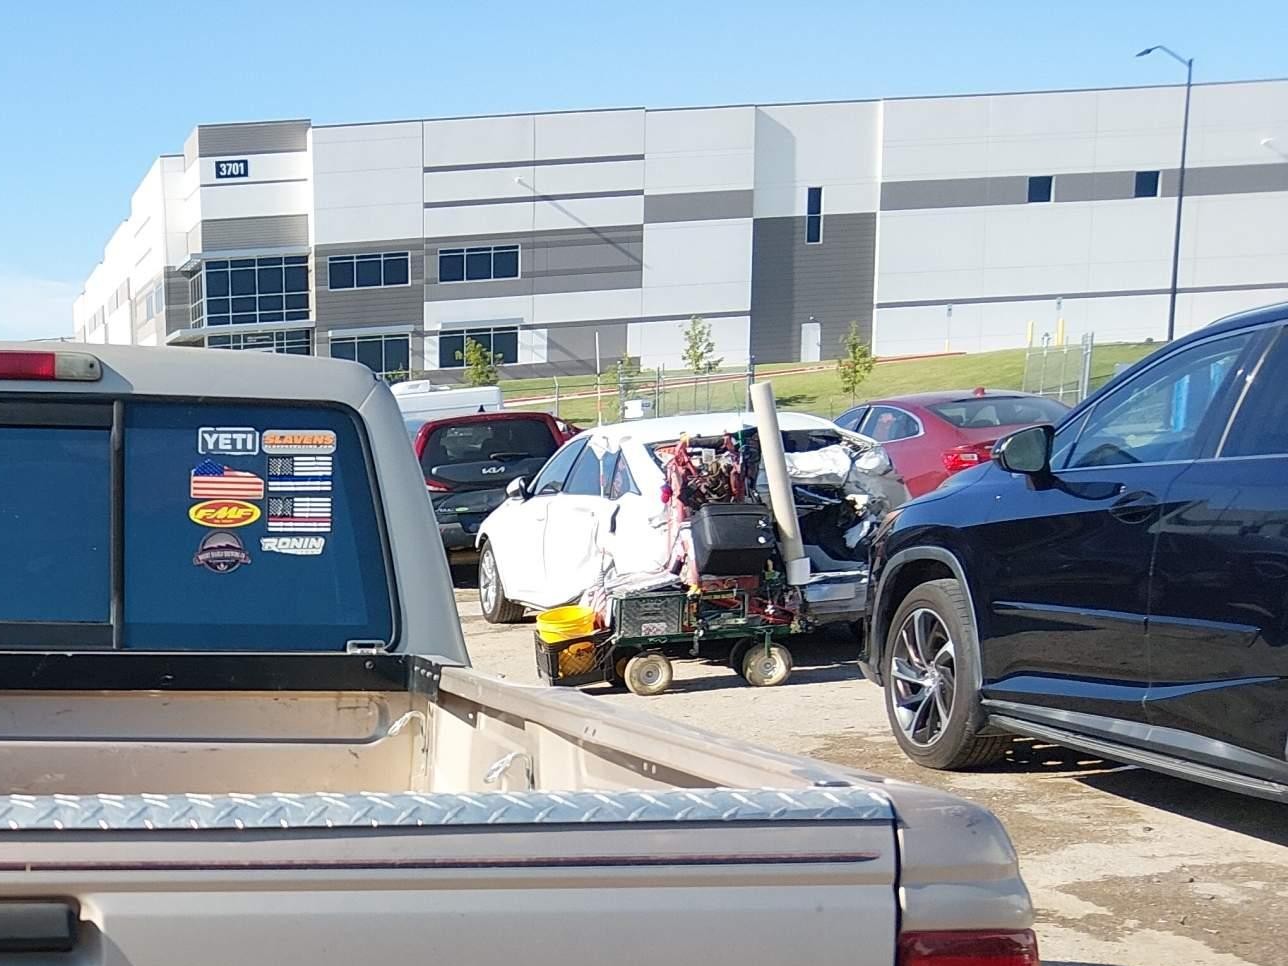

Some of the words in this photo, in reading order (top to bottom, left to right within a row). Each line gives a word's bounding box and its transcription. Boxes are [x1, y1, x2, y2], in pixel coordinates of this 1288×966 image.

[219, 162, 245, 176] 3701
[202, 433, 253, 450] YETI
[263, 435, 335, 445] SLAVENS
[194, 506, 252, 520] FMF
[263, 537, 323, 550] RONIN
